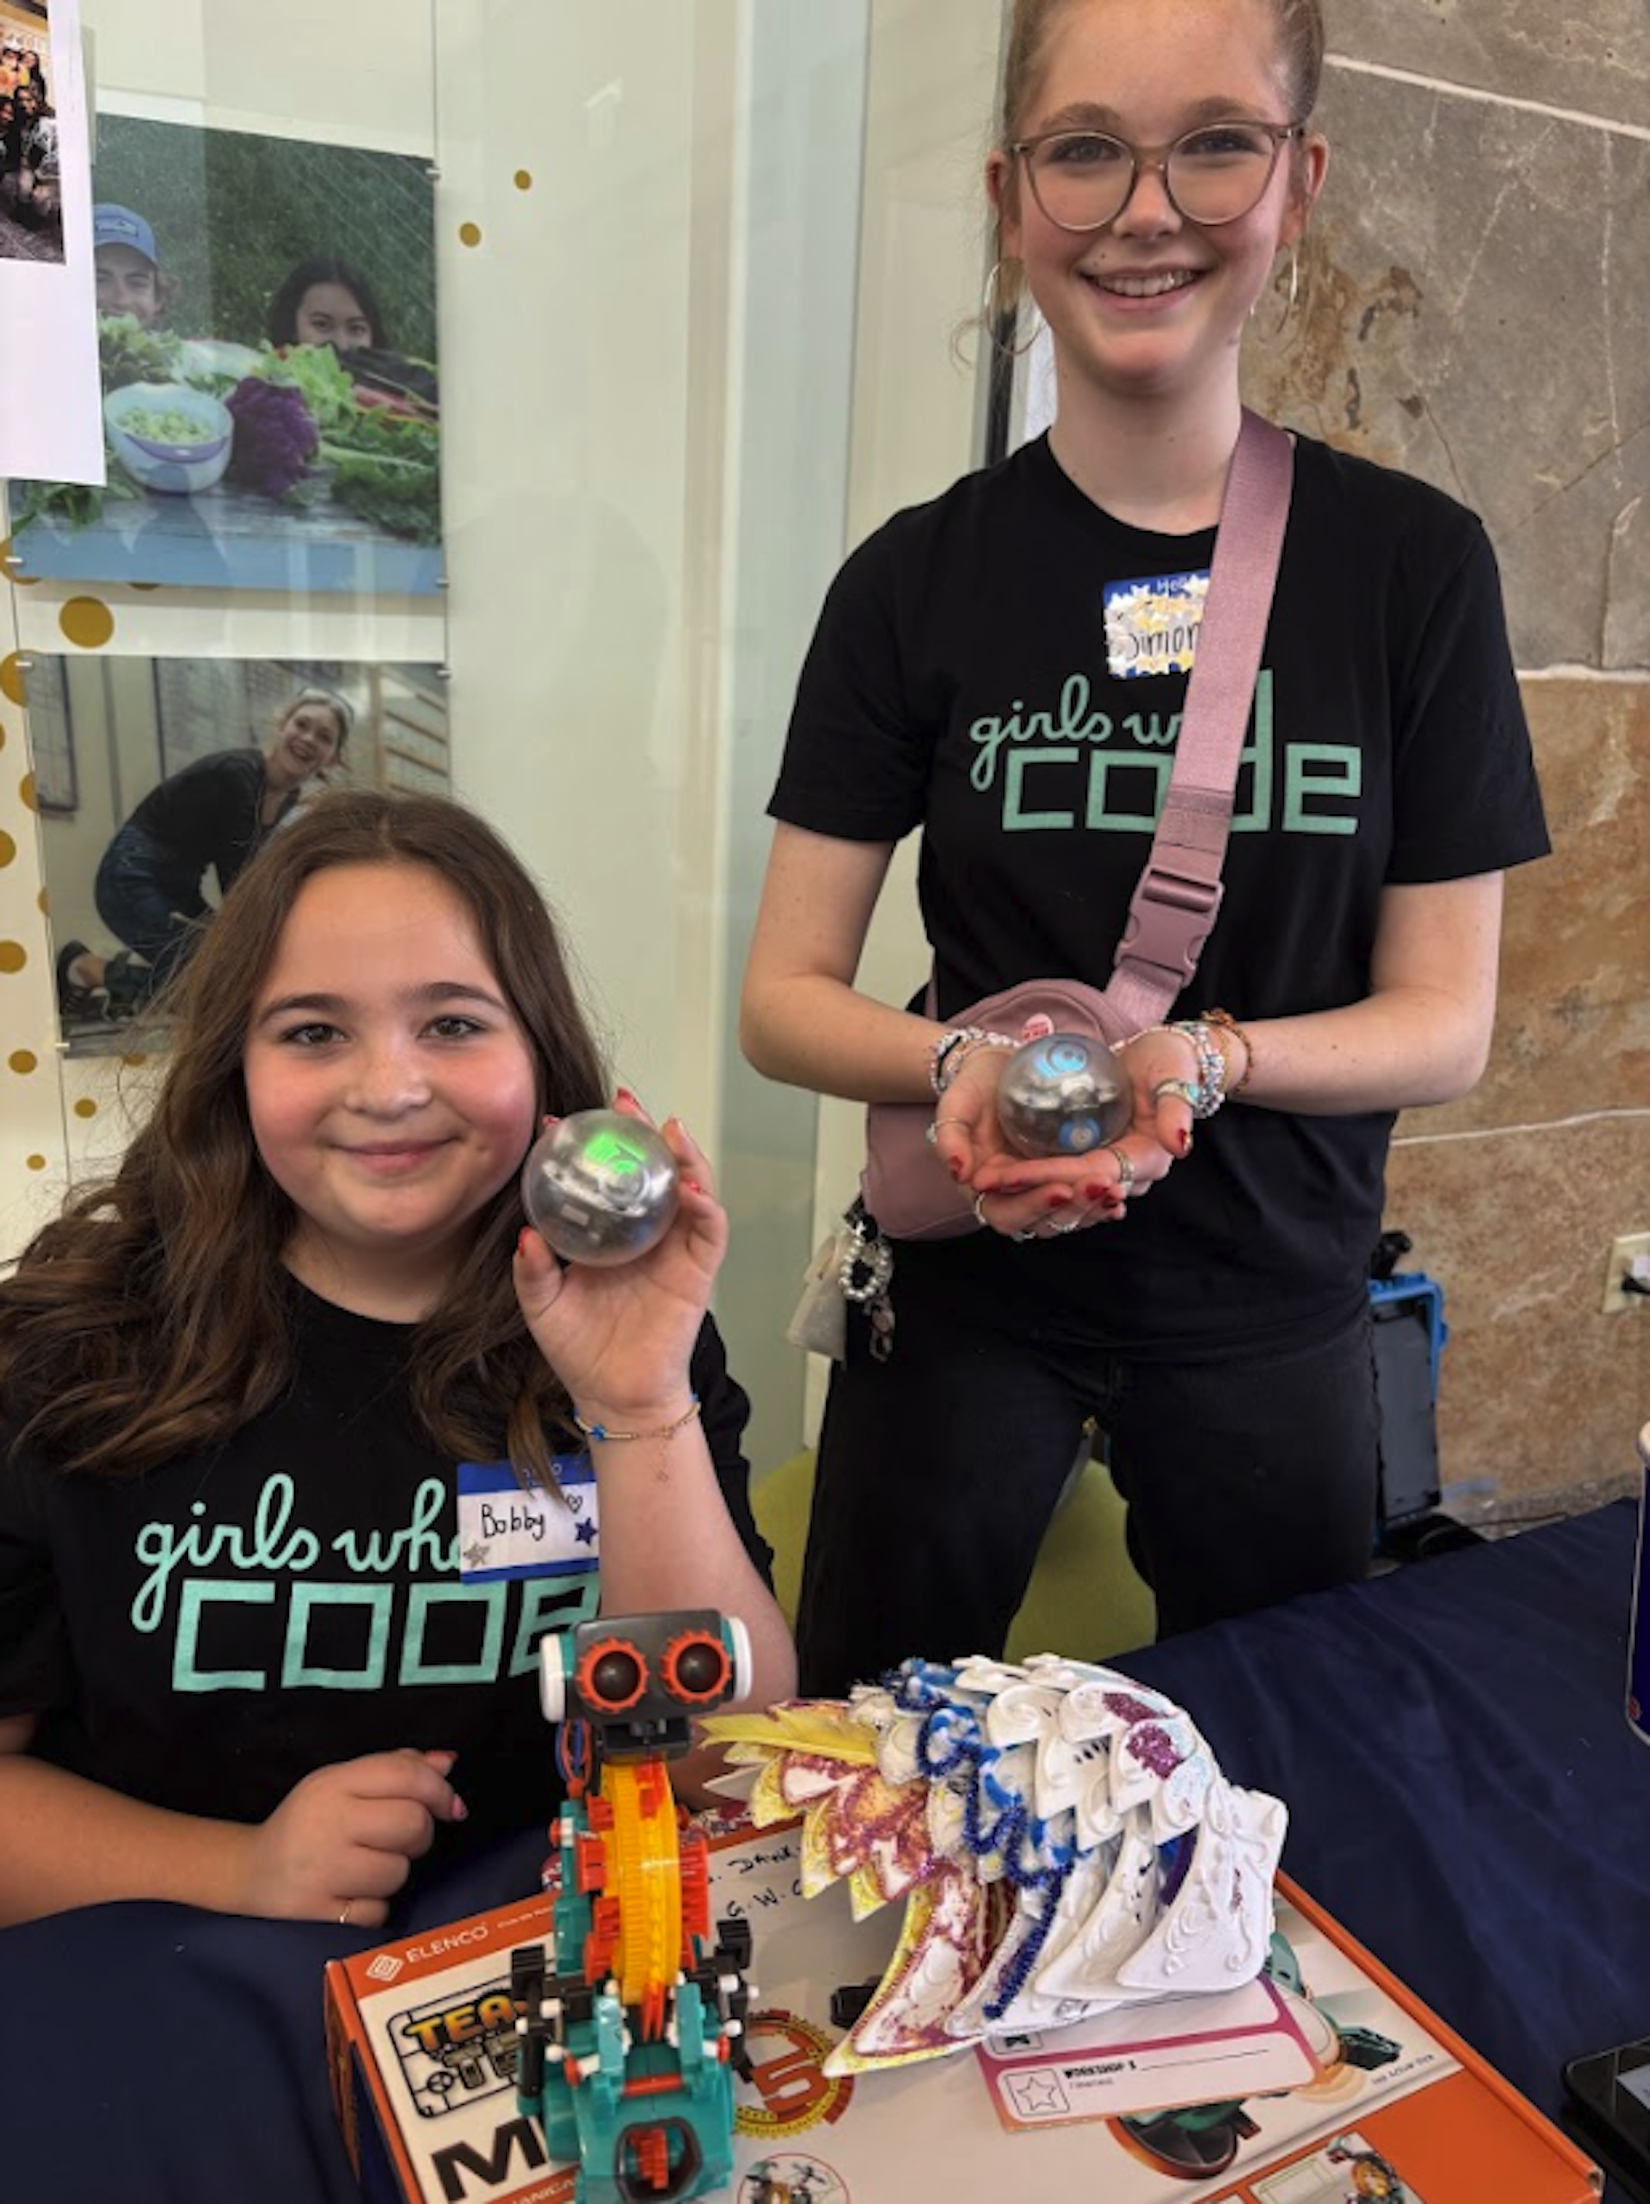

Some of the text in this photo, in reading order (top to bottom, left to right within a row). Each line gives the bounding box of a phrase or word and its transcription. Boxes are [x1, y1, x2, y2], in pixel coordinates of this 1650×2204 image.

[969, 673, 1113, 791] girls
[132, 1473, 320, 1632] girls
[481, 1503, 545, 1541] Bobby
[405, 1924, 488, 1964] ELENCO
